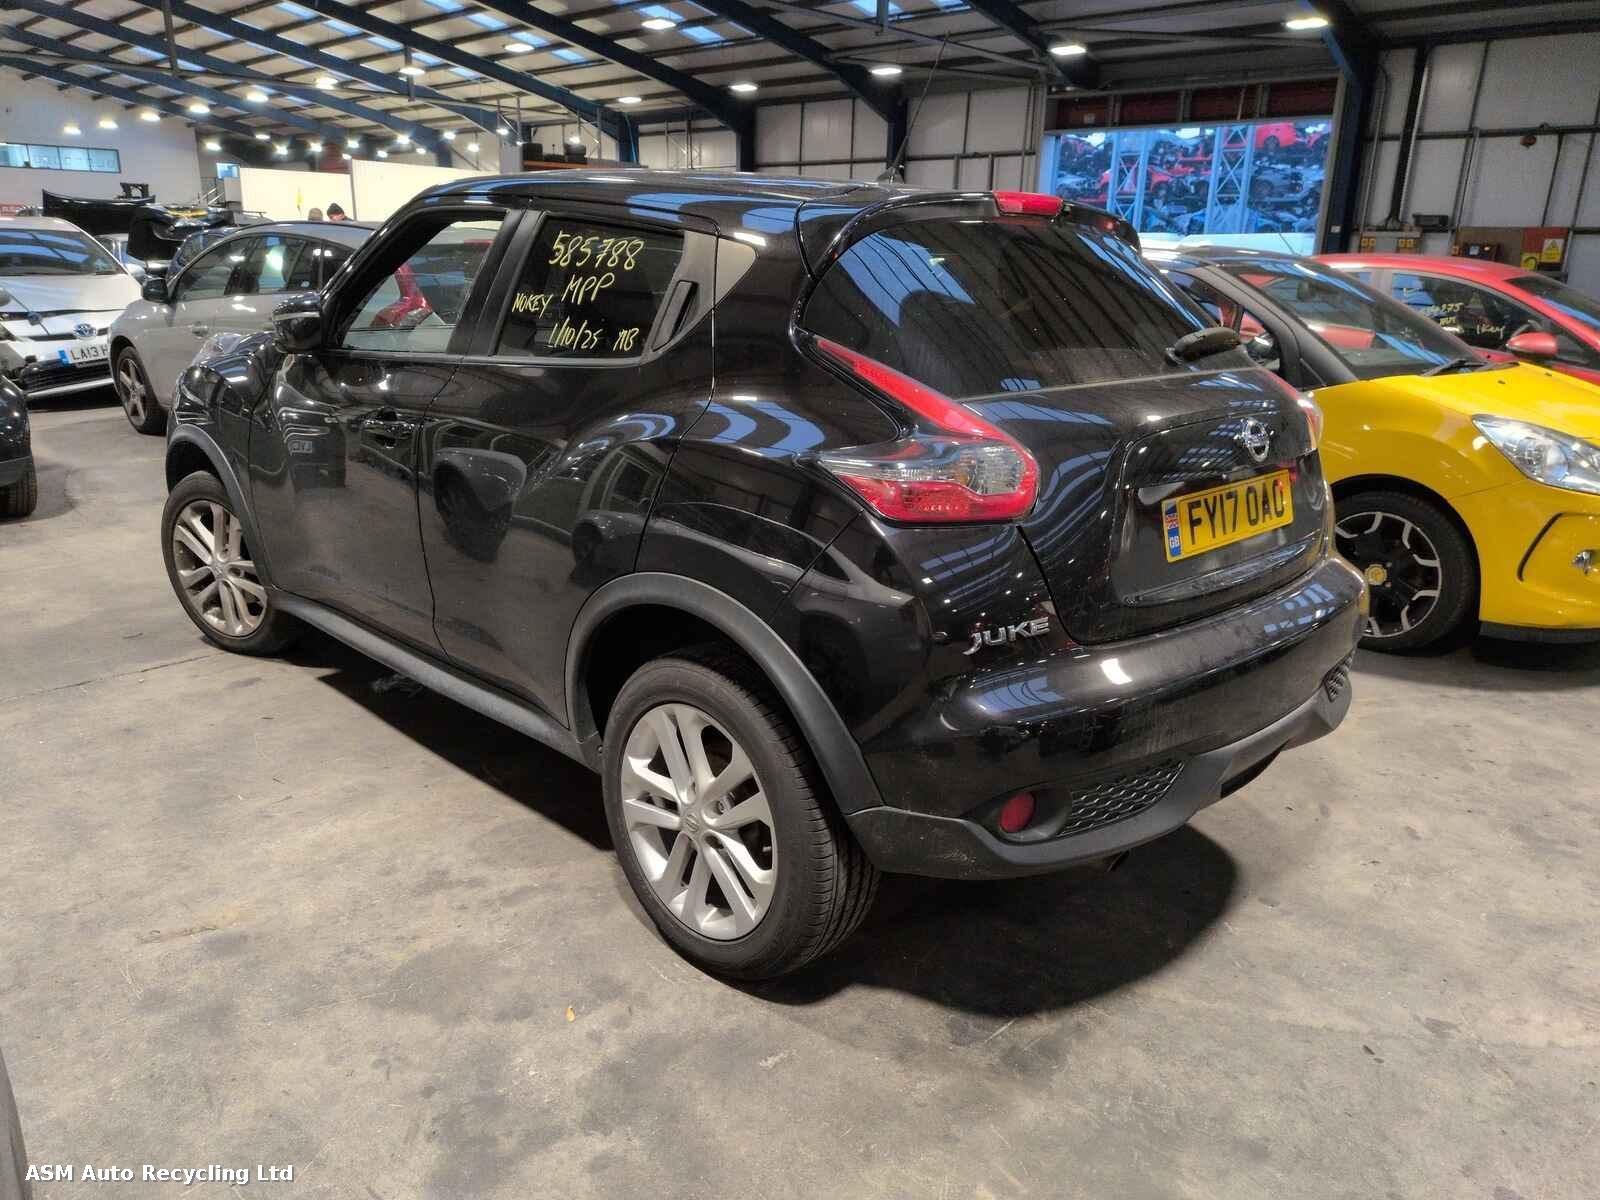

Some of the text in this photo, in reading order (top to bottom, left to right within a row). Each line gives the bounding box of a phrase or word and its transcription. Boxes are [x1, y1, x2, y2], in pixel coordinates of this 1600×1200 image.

[549, 229, 645, 271] 585788
[561, 272, 616, 305] MPP
[70, 346, 99, 361] LA13
[1187, 491, 1239, 545] FY17
[962, 616, 1050, 656] JUKE
